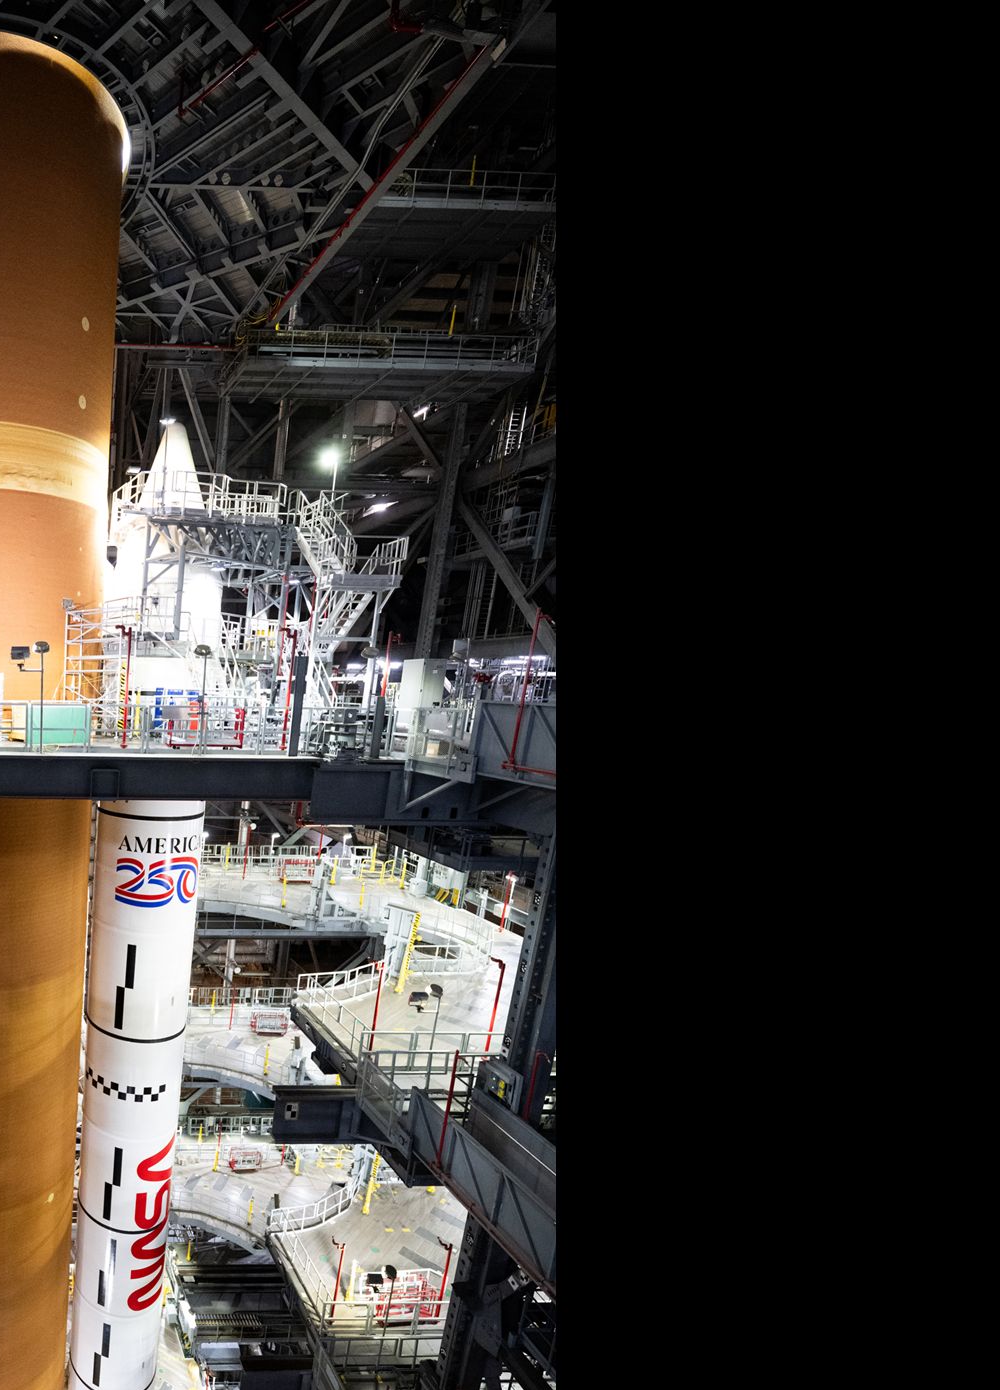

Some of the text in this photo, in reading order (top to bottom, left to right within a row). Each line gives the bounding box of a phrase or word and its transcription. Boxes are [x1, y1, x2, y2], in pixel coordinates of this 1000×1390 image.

[118, 834, 200, 854] AMERIC
[114, 856, 199, 909] 250
[127, 1132, 176, 1313] NASA
